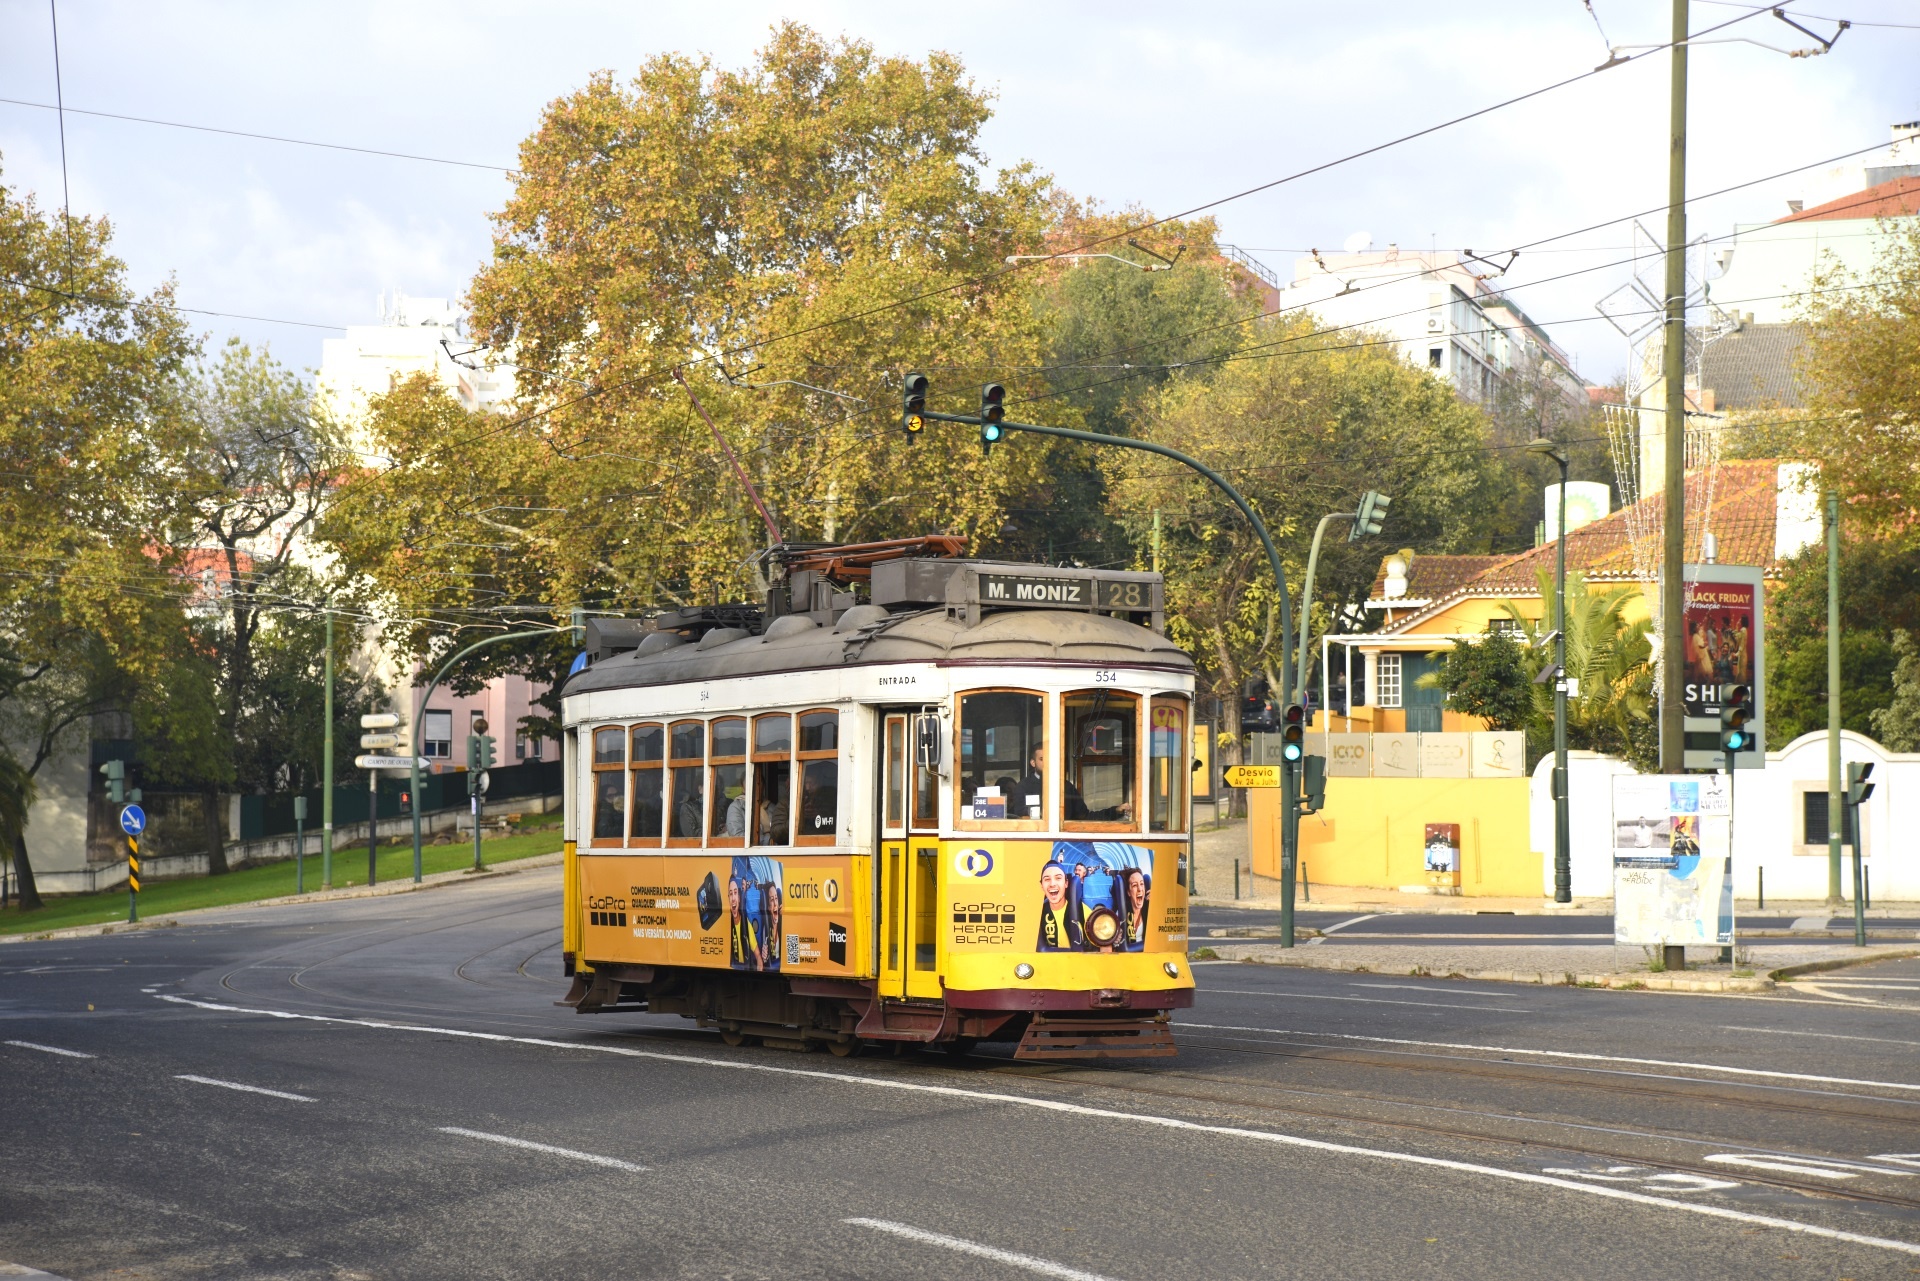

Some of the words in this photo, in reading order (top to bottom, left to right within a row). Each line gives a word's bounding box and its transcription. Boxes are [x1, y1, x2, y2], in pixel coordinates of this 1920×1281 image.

[988, 582, 1010, 599] M.
[1016, 584, 1081, 602] MONIZ
[1109, 583, 1141, 606] 28
[1685, 592, 1716, 602] BLACK
[1718, 592, 1750, 604] FRIDAY
[879, 676, 916, 686] ENTRADA
[1095, 670, 1116, 682] 554
[1238, 768, 1273, 776] Desvio
[974, 810, 987, 818] 04
[630, 886, 662, 896] COMPANHEIRA
[677, 886, 690, 896] PARA
[789, 877, 819, 900] carris
[589, 896, 626, 910] GoPro
[632, 898, 656, 908] QUALQUER
[656, 899, 680, 910] AVENTURA
[953, 902, 1016, 912] GoPro
[632, 915, 637, 925] A
[637, 916, 667, 926] ACTION-CAM
[633, 928, 644, 938] MAIS
[645, 926, 666, 939] VERSÁTIL
[666, 930, 674, 940] DO
[674, 930, 692, 940] MUNDO
[953, 925, 1015, 934] HERO12
[700, 937, 724, 946] HERO12
[829, 929, 846, 943] fnac
[955, 936, 1013, 944] BLACK
[700, 946, 724, 955] BLACK
